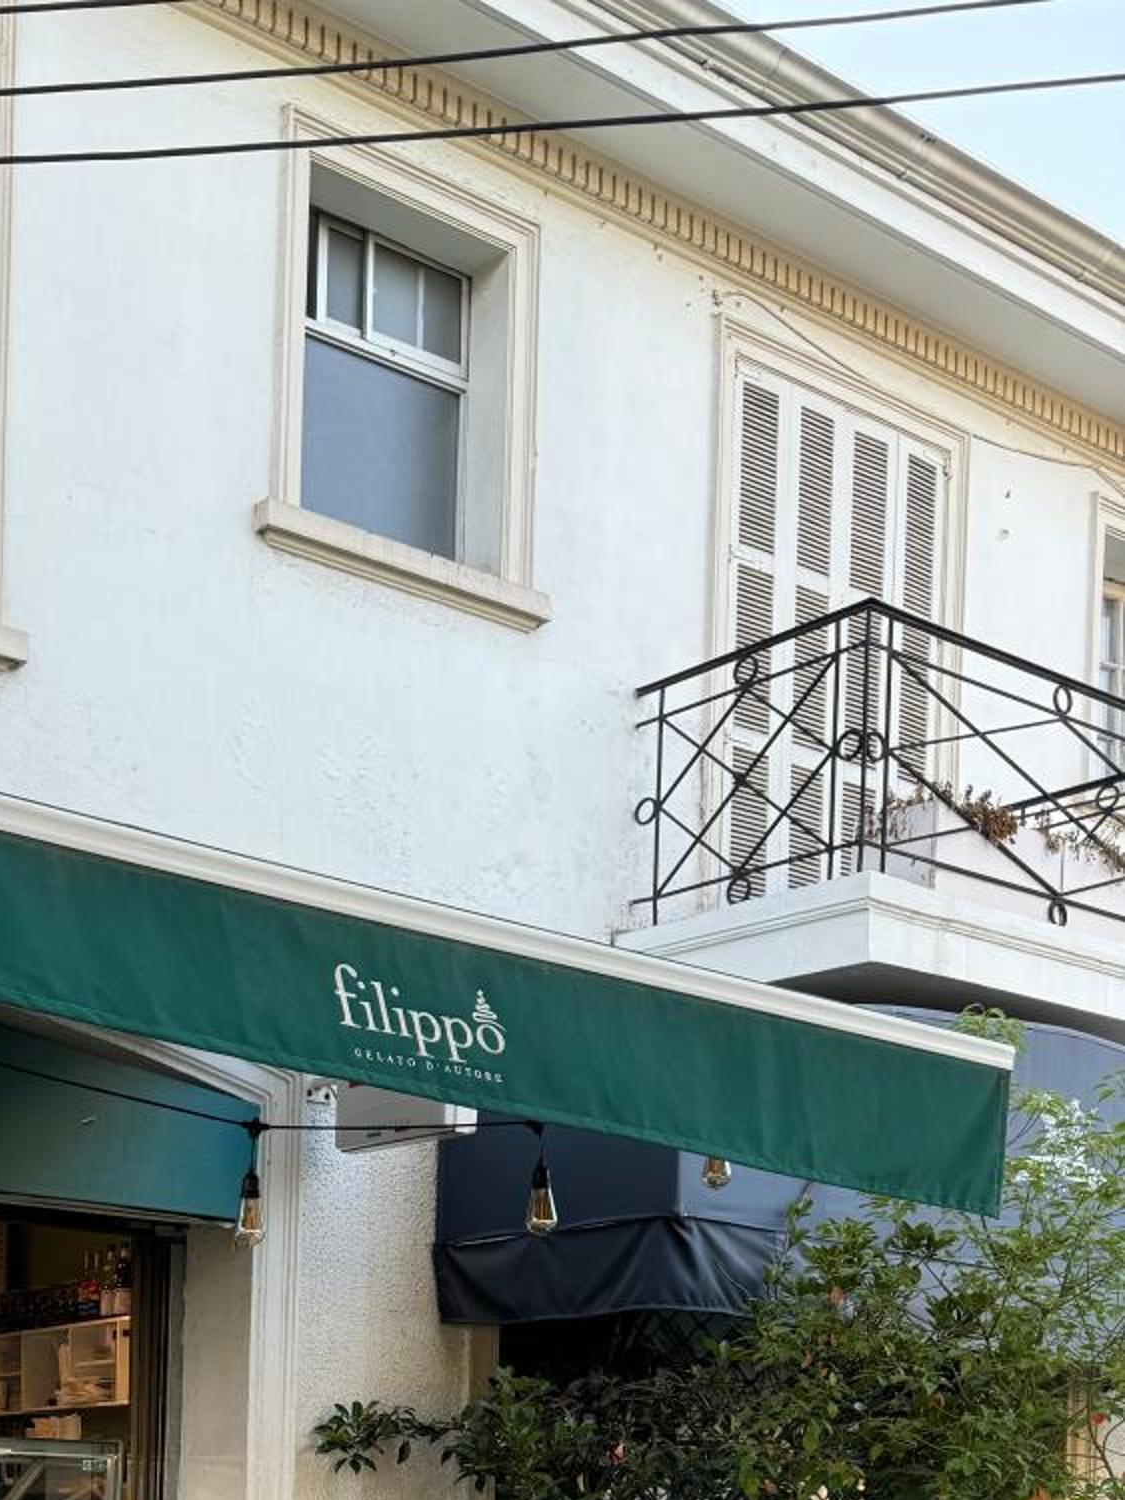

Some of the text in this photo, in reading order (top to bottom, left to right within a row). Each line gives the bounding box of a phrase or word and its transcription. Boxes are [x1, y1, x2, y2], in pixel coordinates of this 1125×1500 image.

[334, 962, 507, 1063] filippo
[354, 1047, 504, 1083] GELATO D'AUTORE
